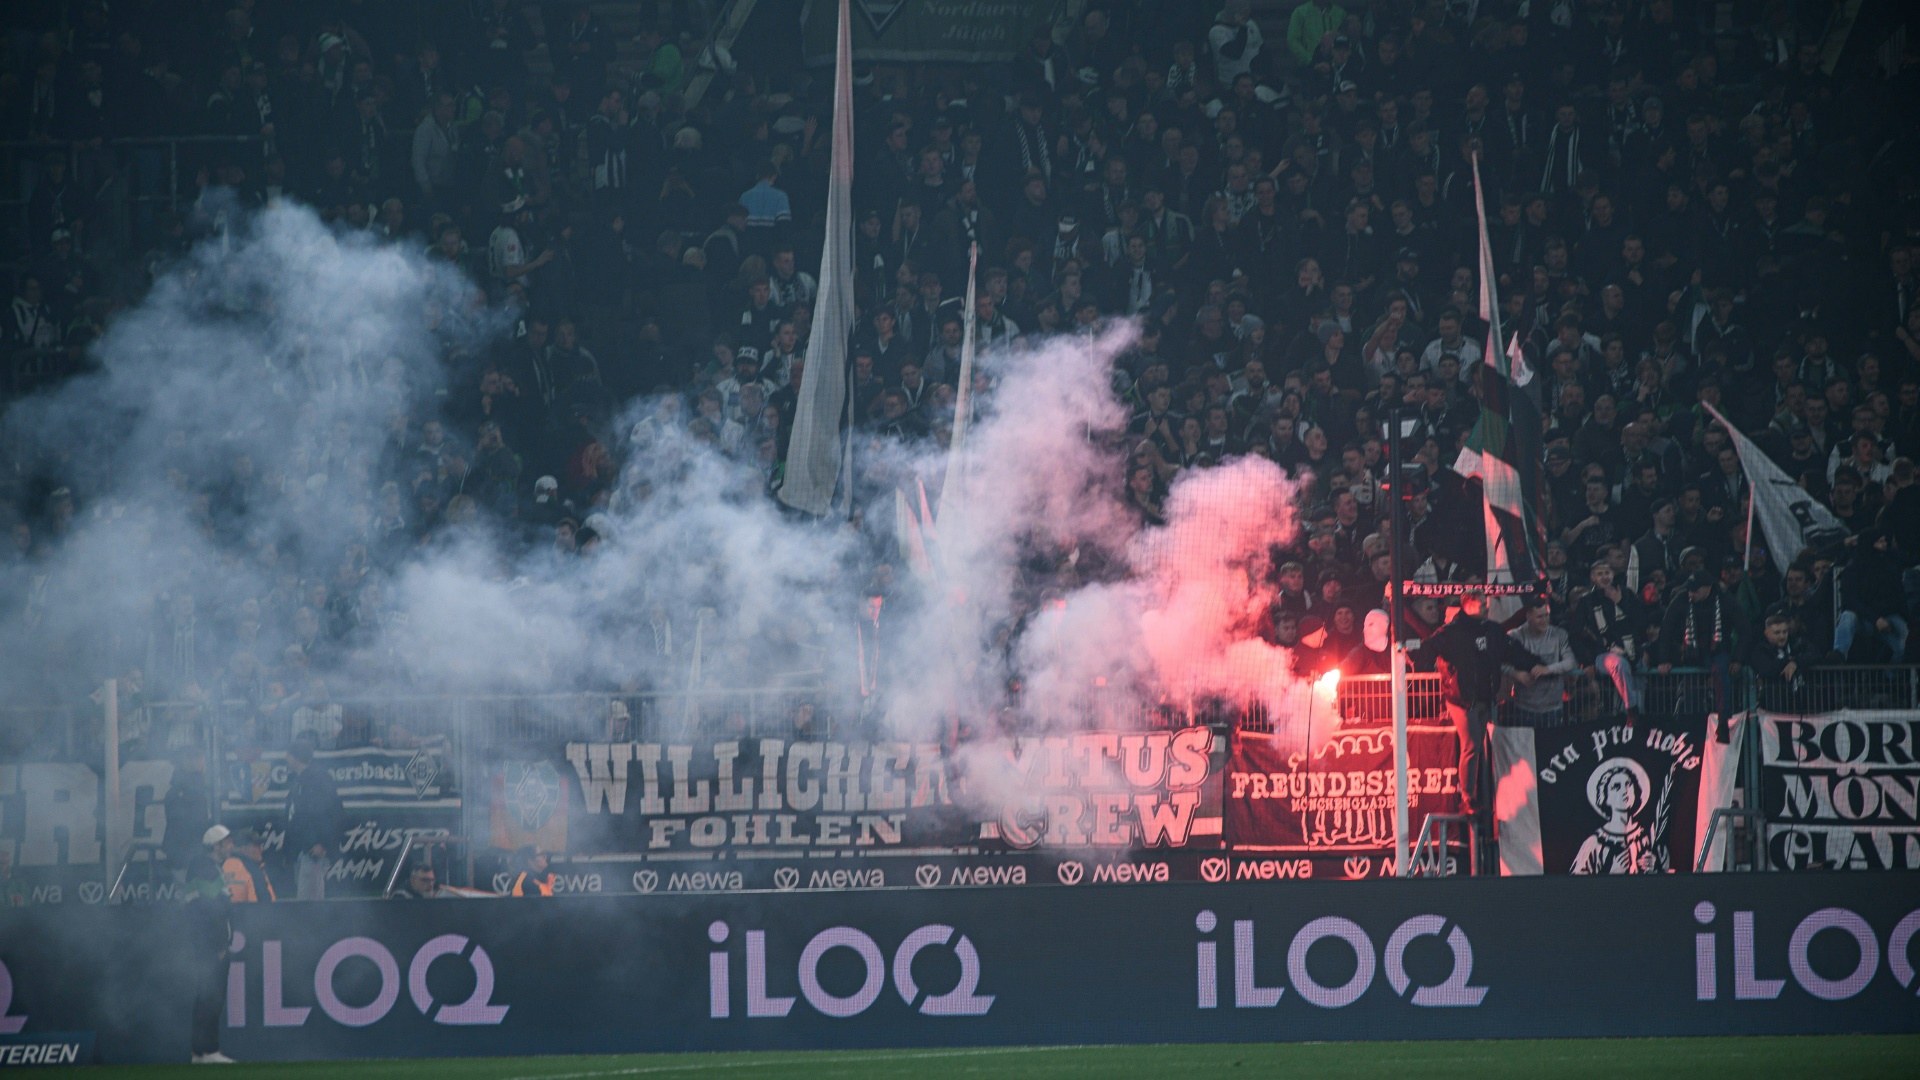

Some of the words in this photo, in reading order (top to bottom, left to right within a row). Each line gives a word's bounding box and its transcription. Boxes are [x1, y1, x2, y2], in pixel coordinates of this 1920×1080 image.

[1001, 727, 1213, 791] VITUS
[1540, 742, 1581, 784] ora
[1590, 725, 1634, 761] pro
[1646, 728, 1700, 771] nobis
[1773, 720, 1920, 765] BOR
[1231, 766, 1462, 799] FREUNDESKREI
[1000, 789, 1203, 850] CREW
[1291, 793, 1419, 813] MÖNCHENGLADBCH
[648, 814, 907, 849] FOHLEN
[552, 873, 602, 893] ewa
[667, 869, 743, 891] mewa
[808, 866, 885, 889] mewa
[950, 863, 1026, 886] mewa
[1092, 861, 1169, 883] mewa
[1235, 858, 1313, 881] mewa
[707, 919, 996, 1019] iLOQ
[1195, 909, 1490, 1009] iLOQ
[226, 930, 510, 1027] iLOQ
